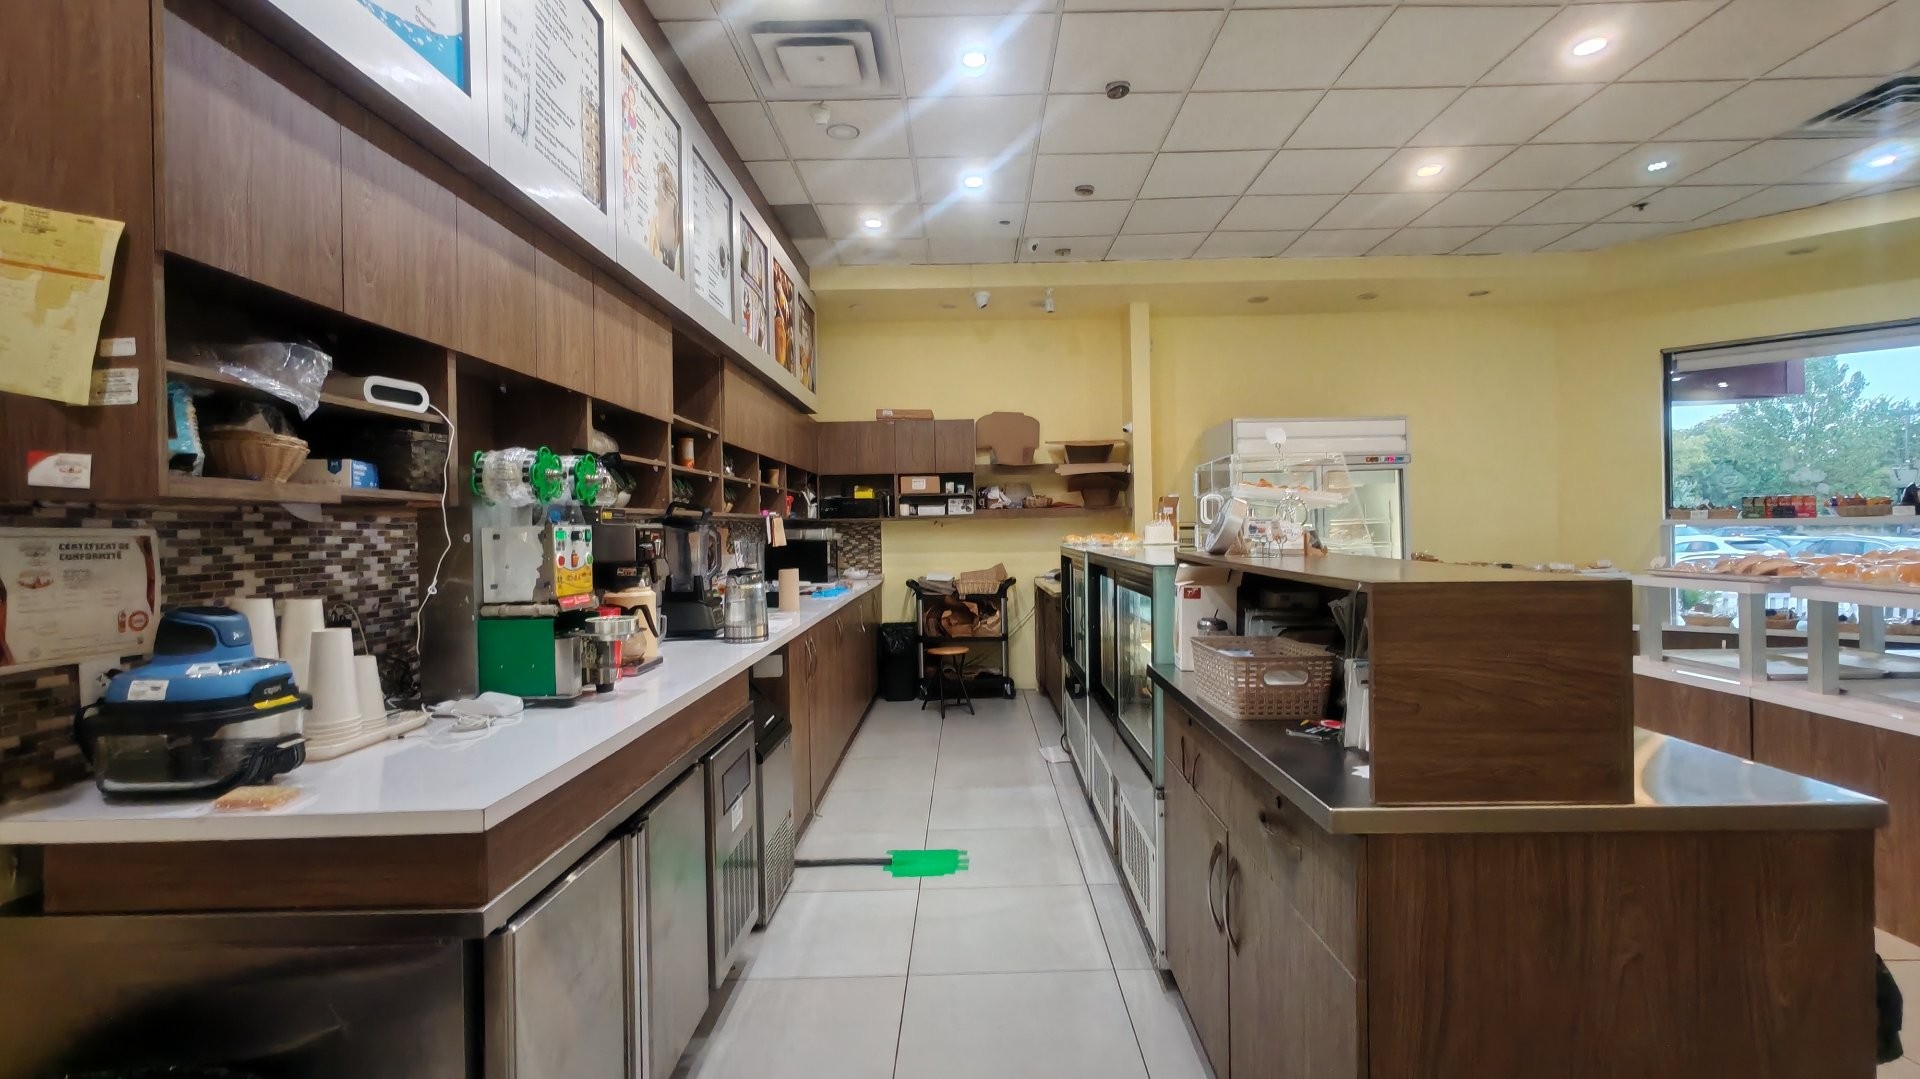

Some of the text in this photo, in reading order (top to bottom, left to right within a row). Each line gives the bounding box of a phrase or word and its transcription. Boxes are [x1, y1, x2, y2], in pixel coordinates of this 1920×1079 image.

[58, 542, 130, 551] CERTIFICAT DE
[58, 550, 122, 561] CONFORMITÉ
